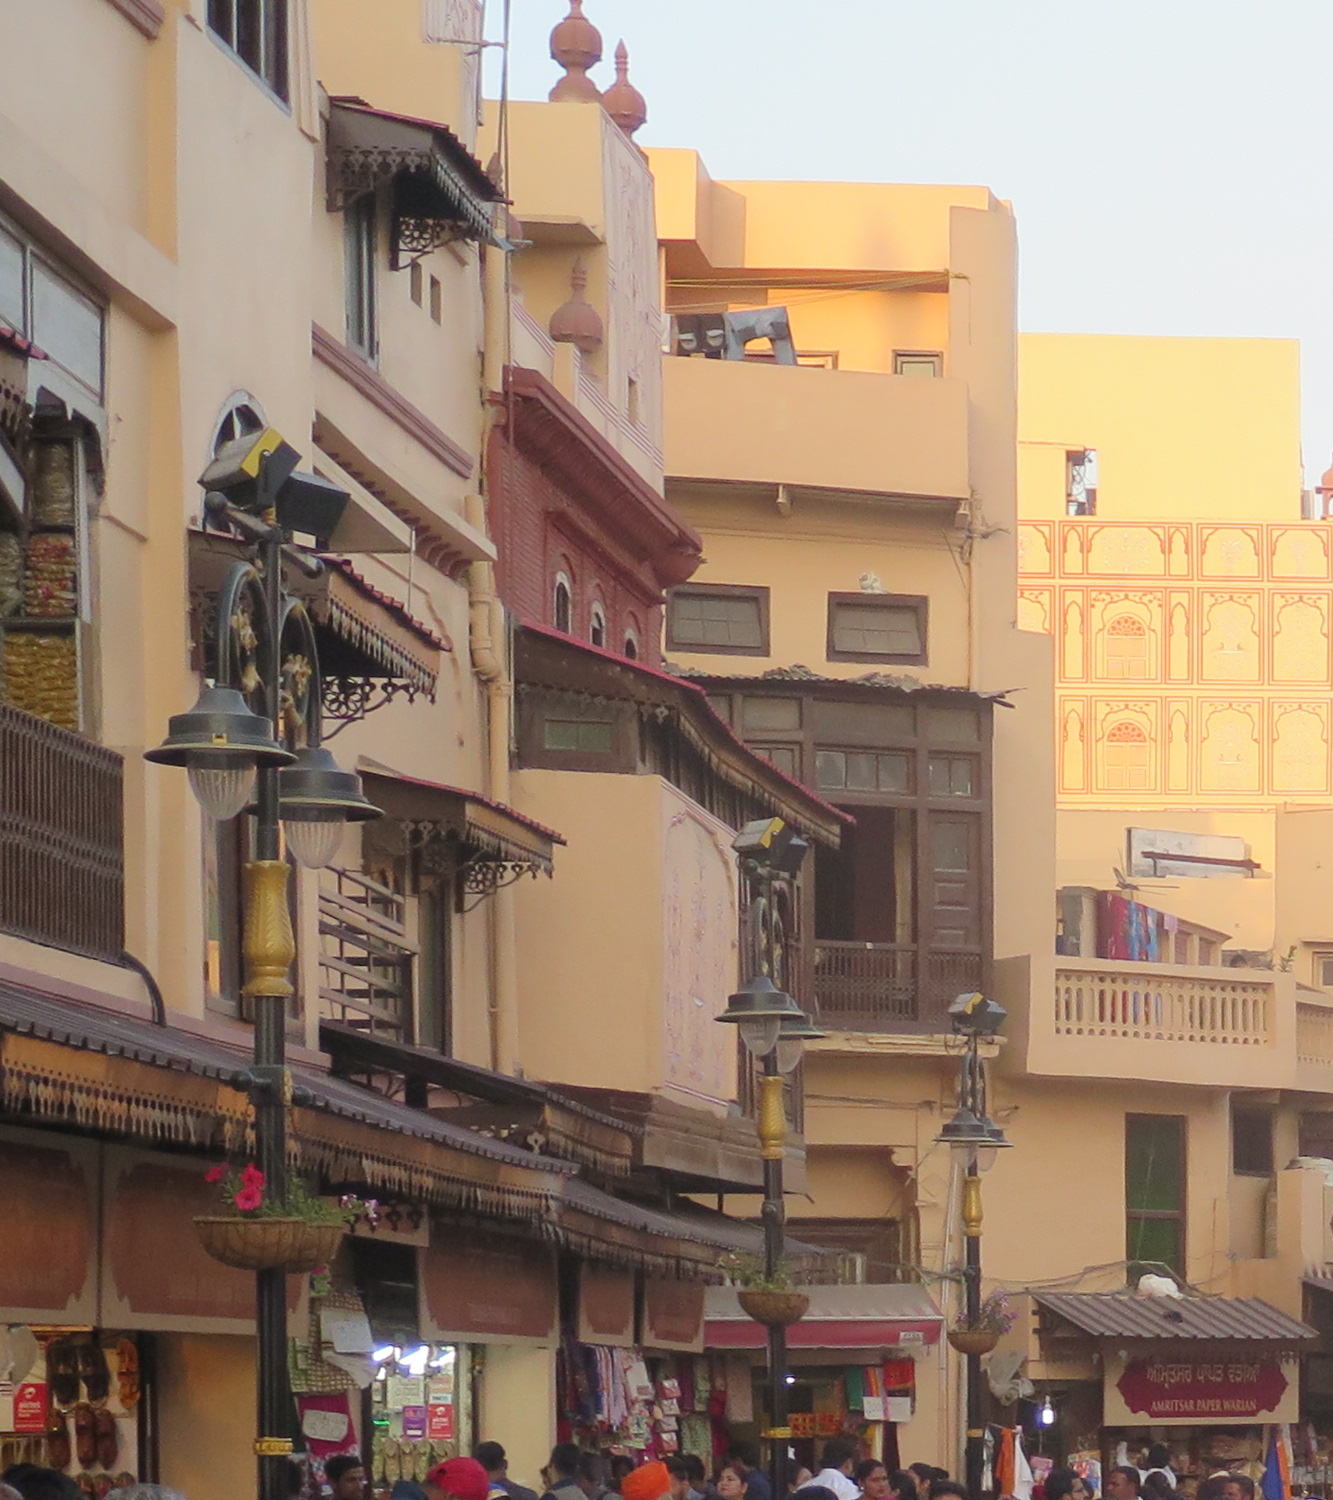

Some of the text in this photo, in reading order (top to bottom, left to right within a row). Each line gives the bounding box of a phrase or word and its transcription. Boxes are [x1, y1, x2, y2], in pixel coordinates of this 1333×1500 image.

[1151, 1399, 1257, 1412] AMRITSAR PAPER WARIAN
